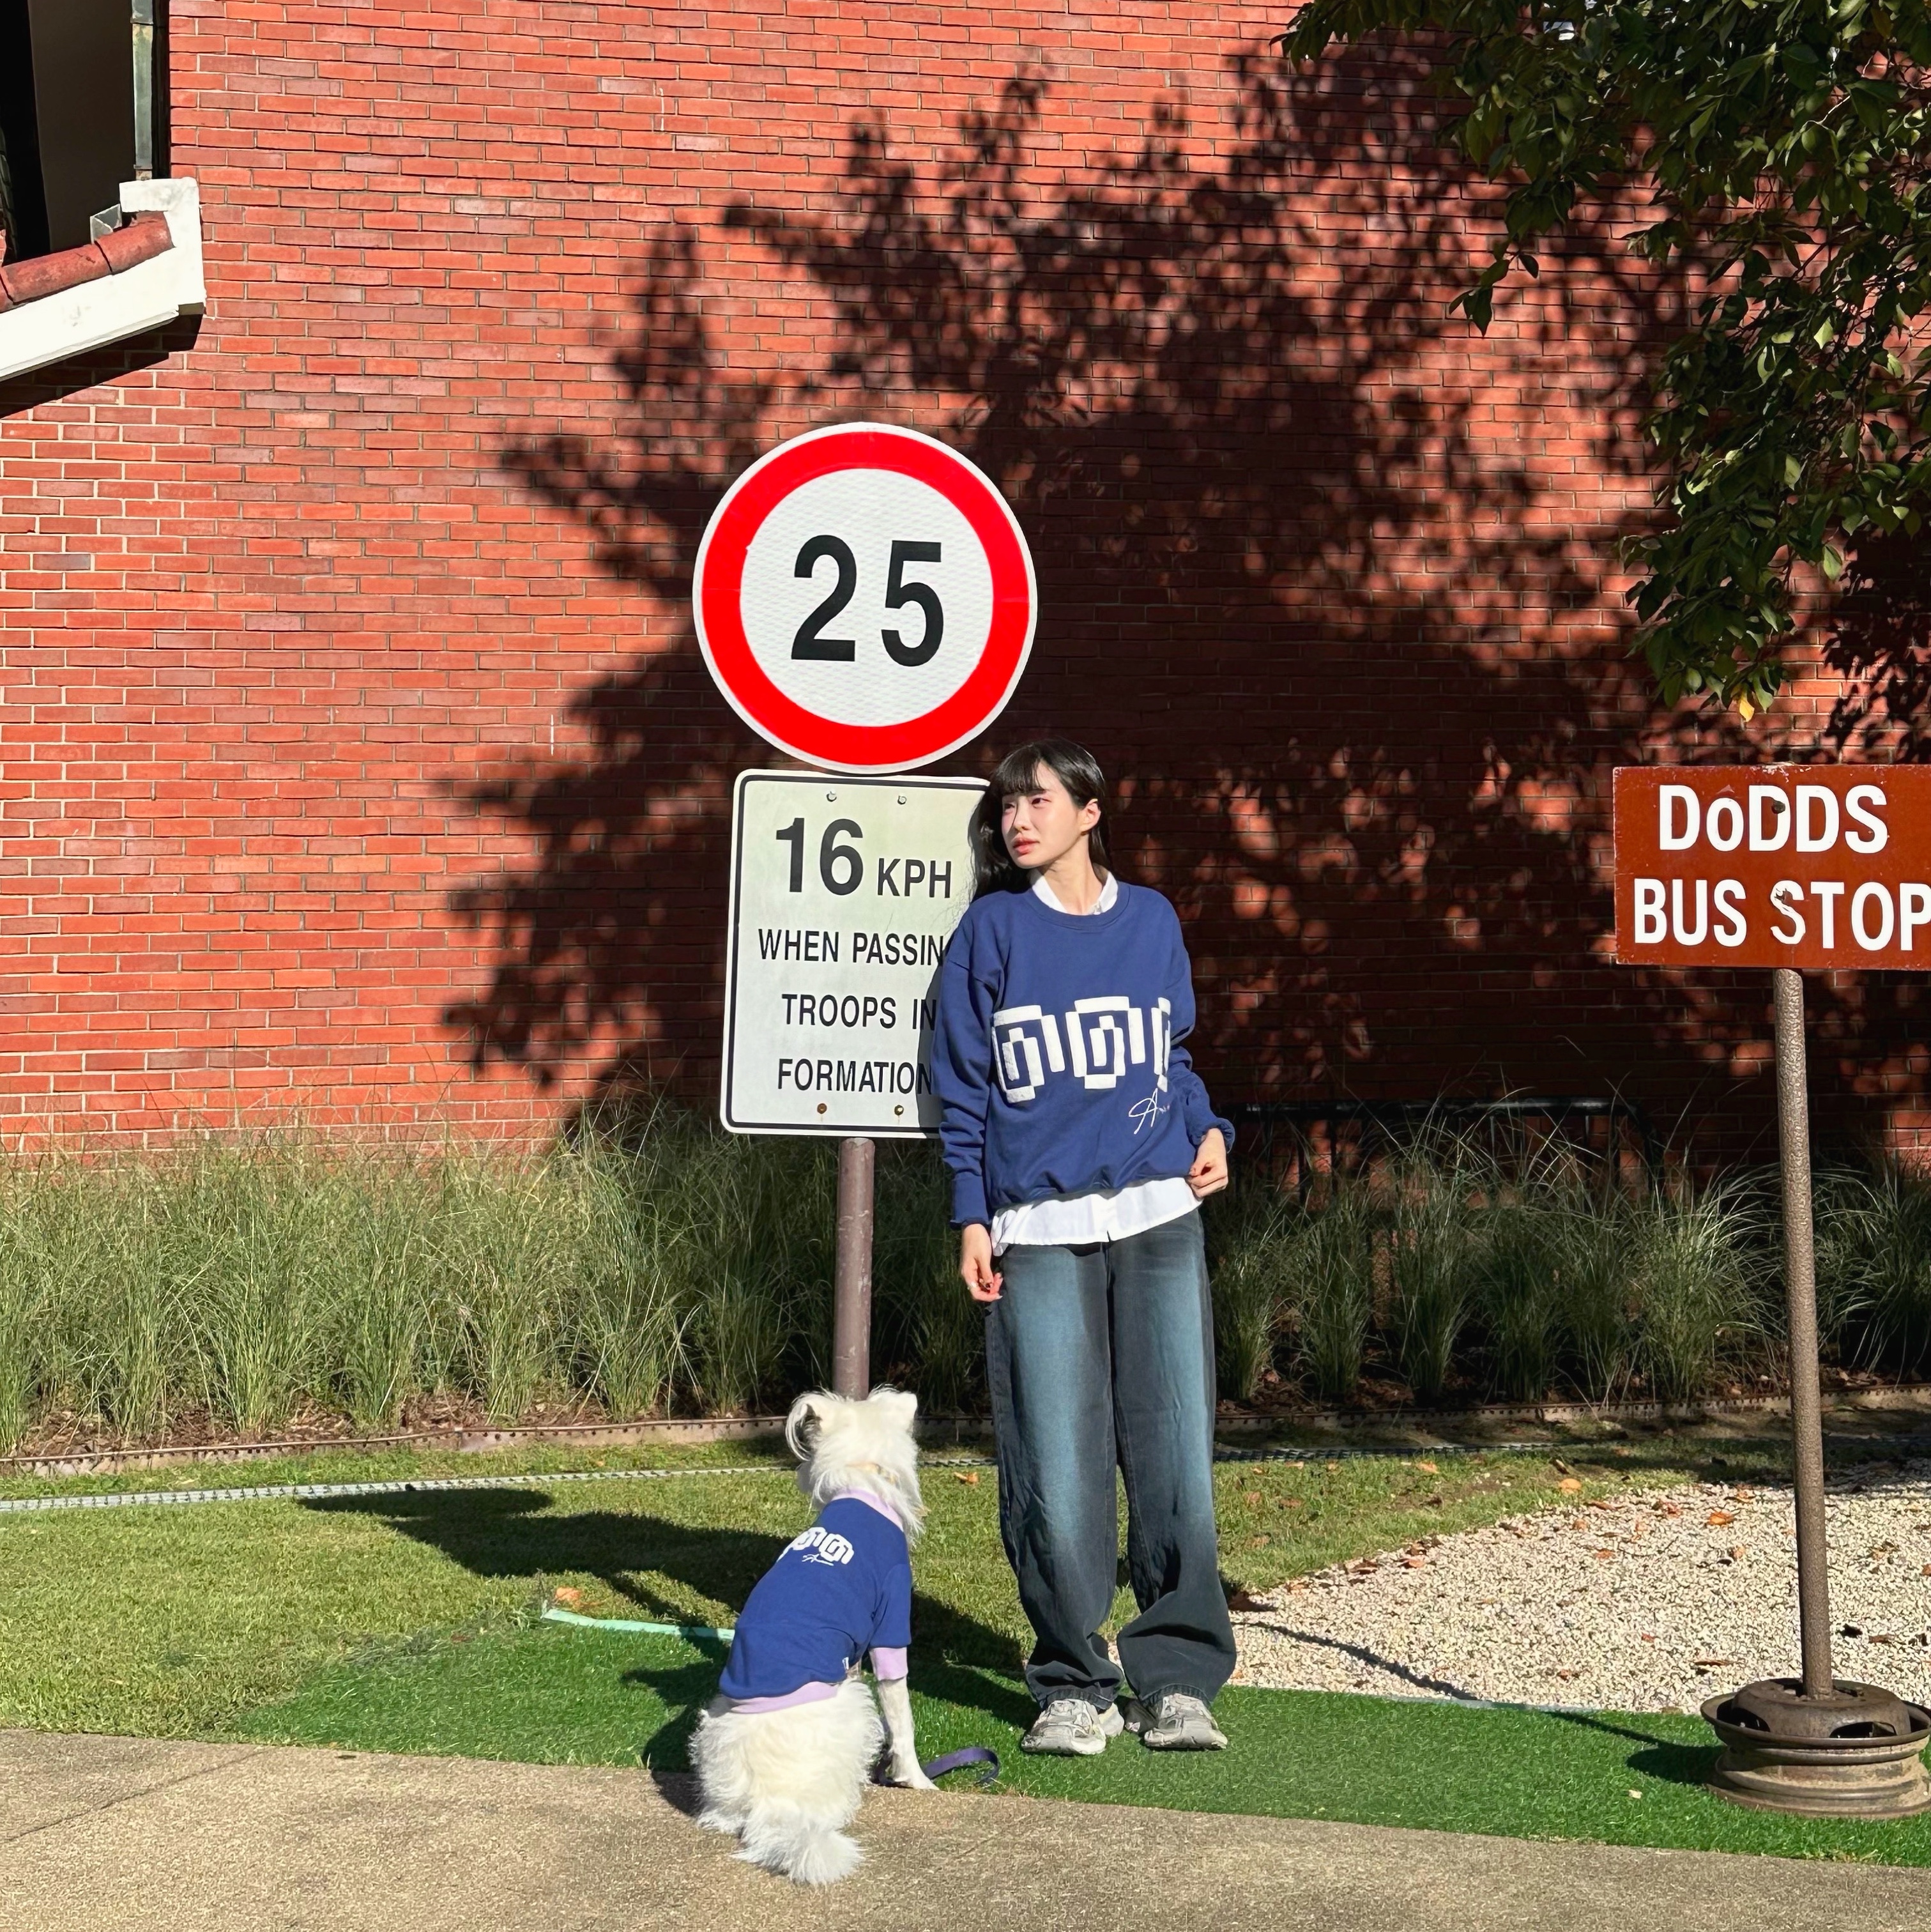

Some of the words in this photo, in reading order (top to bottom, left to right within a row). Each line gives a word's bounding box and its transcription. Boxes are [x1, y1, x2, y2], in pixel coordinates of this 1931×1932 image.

[791, 534, 944, 667] 25
[1659, 785, 1891, 854] DoDDS
[775, 817, 864, 896] 16
[877, 857, 952, 898] KPH
[758, 928, 839, 962] WHEN
[853, 932, 944, 967] PASSIN
[1634, 878, 1748, 947] BUS
[1770, 880, 1931, 951] STOP
[781, 993, 896, 1029] TROOPS
[912, 999, 937, 1031] IN
[778, 1058, 932, 1095] FORMATION
